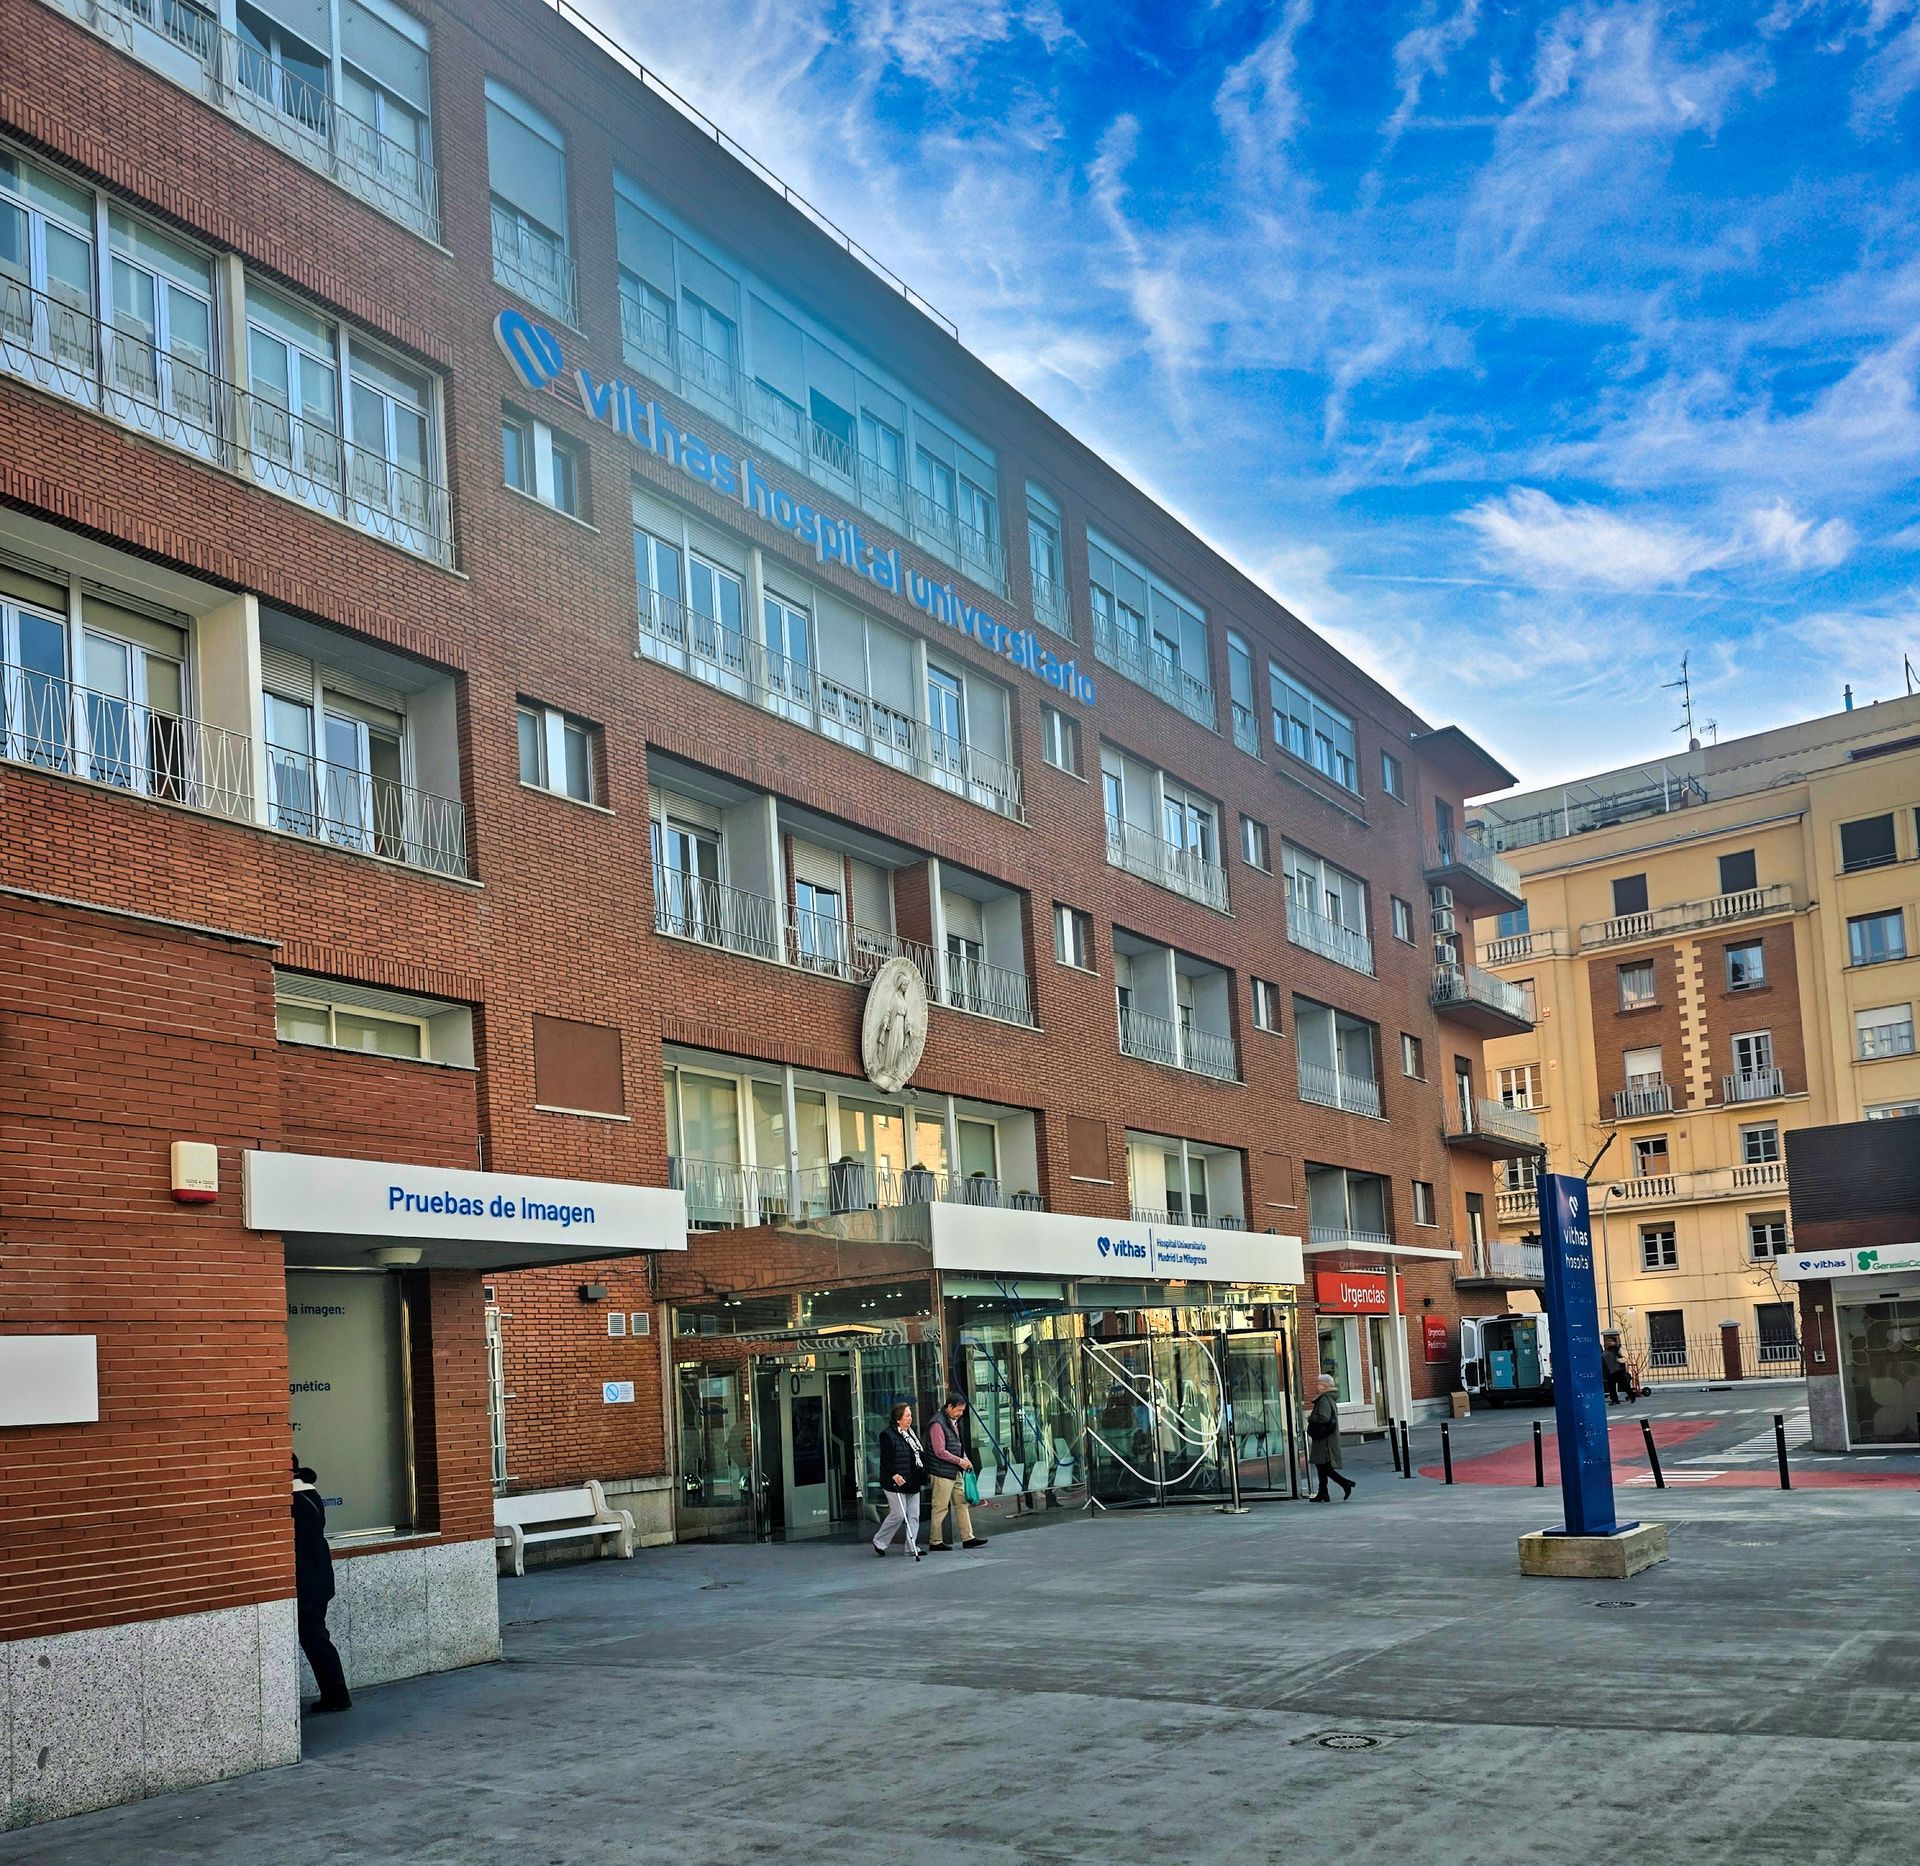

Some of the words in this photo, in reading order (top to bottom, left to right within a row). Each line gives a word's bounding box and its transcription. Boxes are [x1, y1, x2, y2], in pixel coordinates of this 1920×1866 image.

[574, 367, 737, 497] vithas
[741, 456, 901, 597] hospital
[905, 567, 1097, 706] universitario
[388, 1186, 484, 1216] Pruebas
[490, 1195, 516, 1218] de
[522, 1197, 595, 1228] Imagen
[1156, 1238, 1177, 1249] Hospital
[1563, 1226, 1589, 1246] vithas
[1113, 1240, 1146, 1258] vithas
[1158, 1252, 1176, 1263] Madrid
[1176, 1254, 1183, 1263] La
[1813, 1259, 1847, 1270] vithas
[1340, 1282, 1386, 1308] Urgencias
[288, 1303, 298, 1315] la
[300, 1303, 345, 1317] imagen:
[1428, 1328, 1446, 1338] Urgencias
